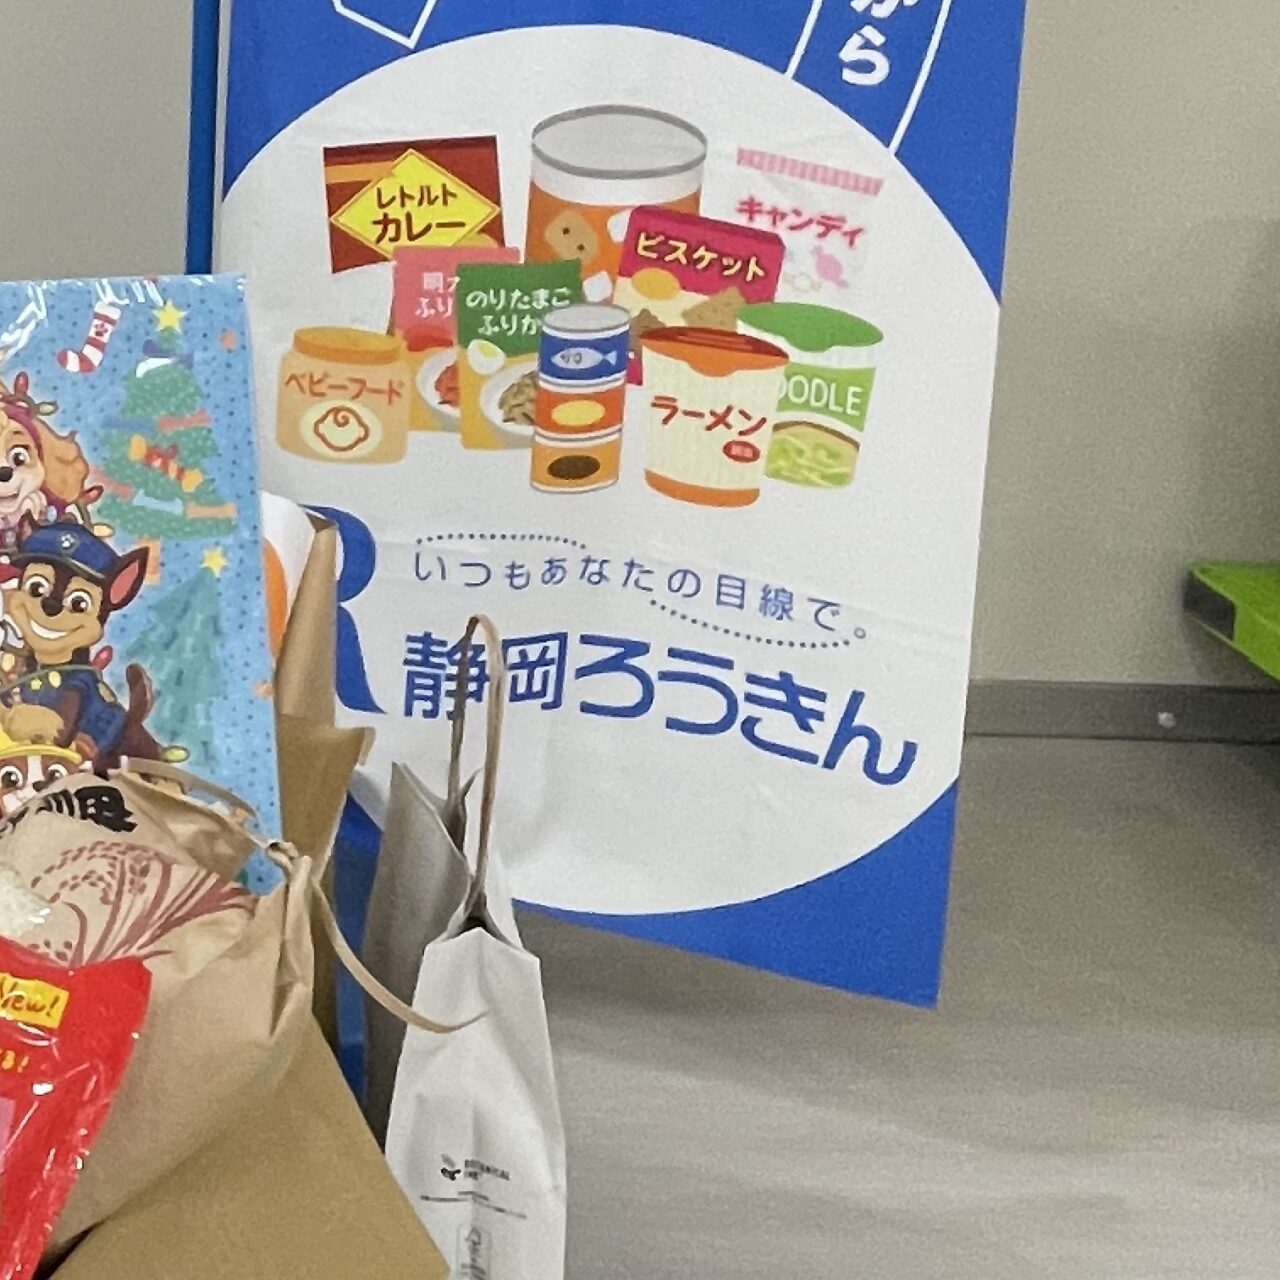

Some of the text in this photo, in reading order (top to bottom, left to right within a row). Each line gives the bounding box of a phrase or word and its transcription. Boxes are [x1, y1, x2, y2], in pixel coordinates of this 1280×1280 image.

[375, 183, 459, 210] レトルト
[371, 214, 467, 245] カレー
[736, 195, 865, 251] キャンディ
[636, 231, 767, 283] ビスケット
[283, 373, 404, 401] ベビーフード
[650, 396, 768, 437] ラーメン
[413, 550, 867, 641] いつもあなたの目線で。
[402, 629, 919, 787] 静岡ろうきん
